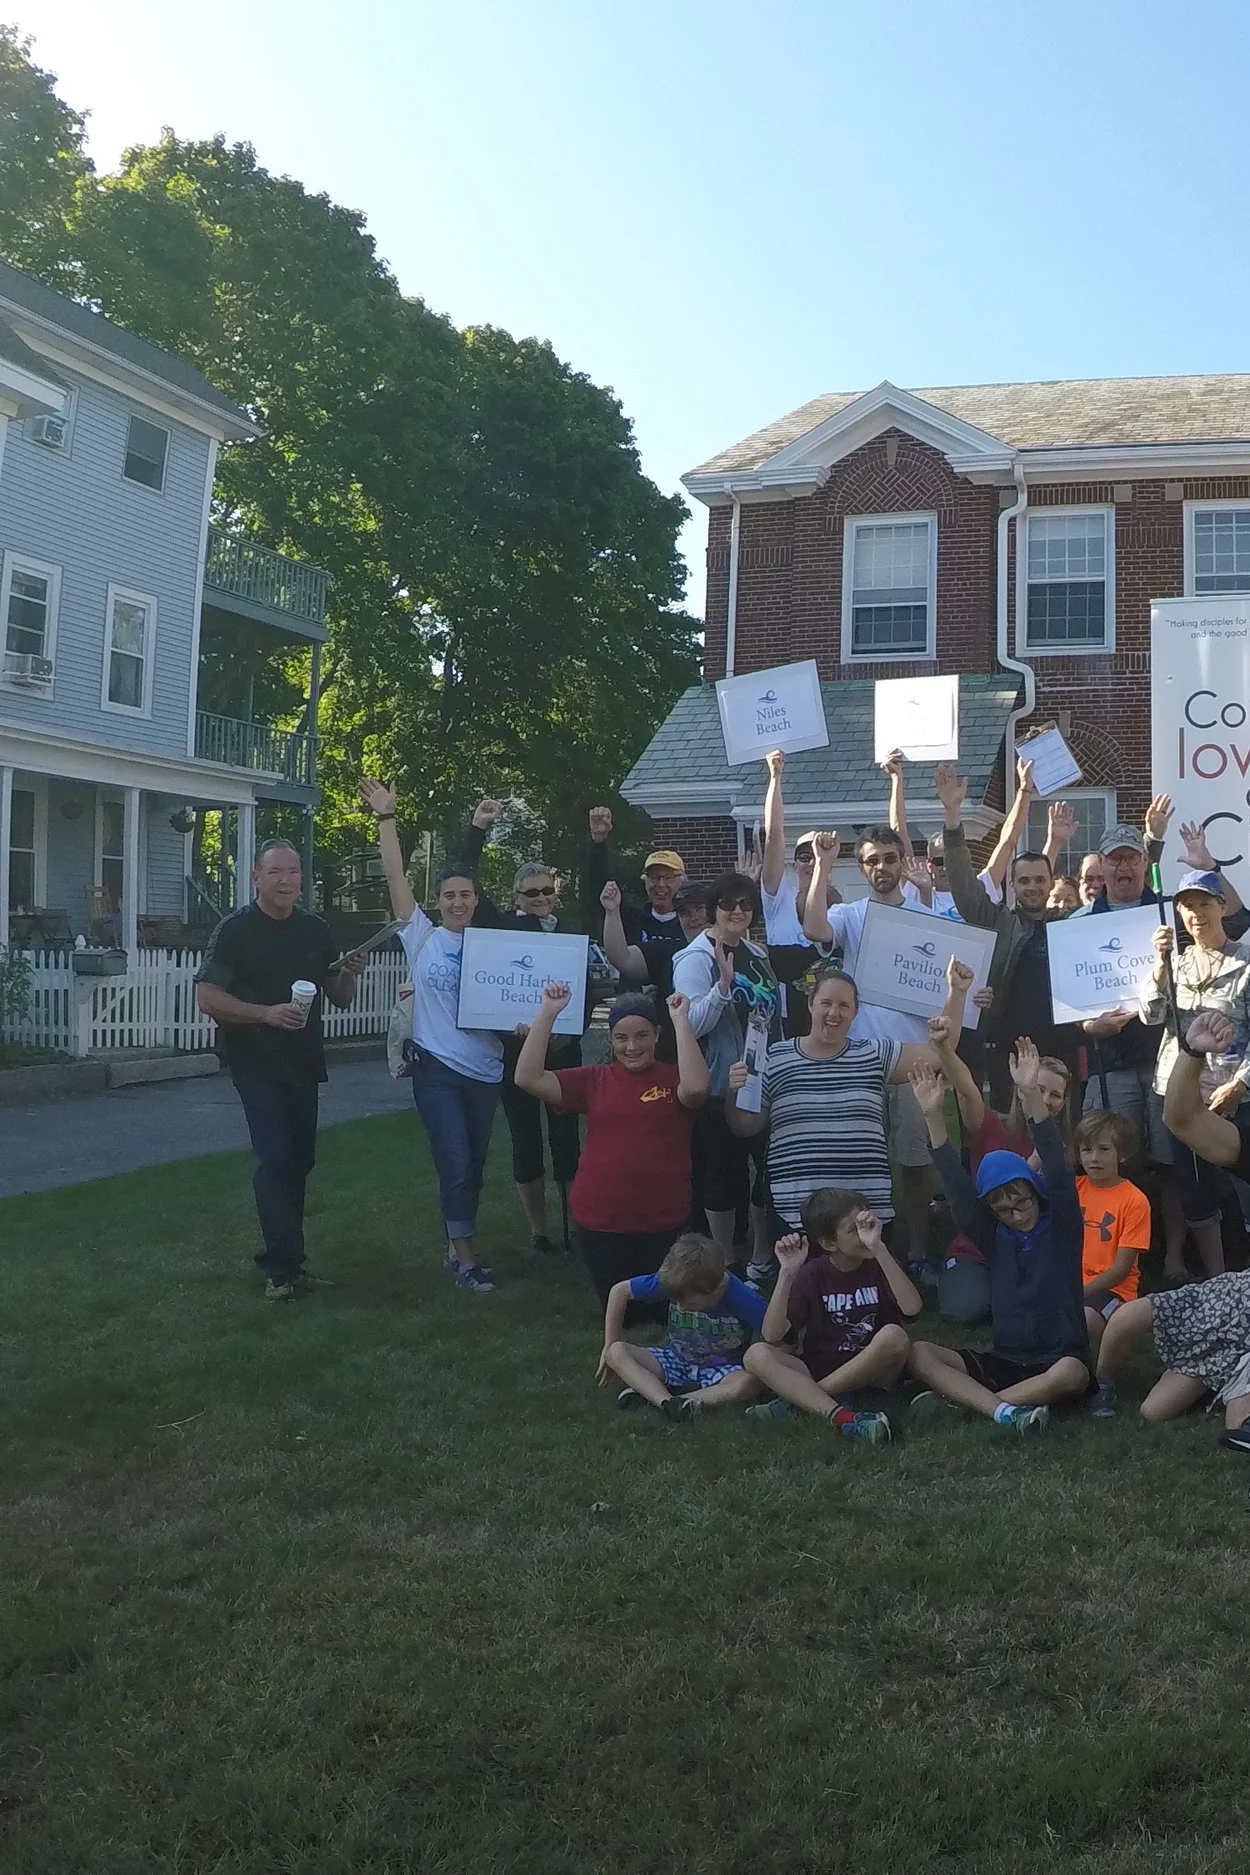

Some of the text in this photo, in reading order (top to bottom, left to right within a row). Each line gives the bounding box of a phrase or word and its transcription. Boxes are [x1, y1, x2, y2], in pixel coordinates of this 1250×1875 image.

[1200, 617, 1233, 628] disciples
[1236, 616, 1247, 625] for
[1191, 630, 1206, 639] and
[1209, 629, 1222, 638] the
[1225, 628, 1247, 639] good
[756, 706, 787, 721] Niles
[756, 717, 792, 736] Beach
[893, 953, 946, 978] Pavilio
[1074, 954, 1155, 977] Plum Cove
[474, 970, 572, 989] Good Harbr
[898, 971, 941, 993] Beach
[1094, 970, 1138, 990] Beach
[500, 988, 543, 1004] Beach
